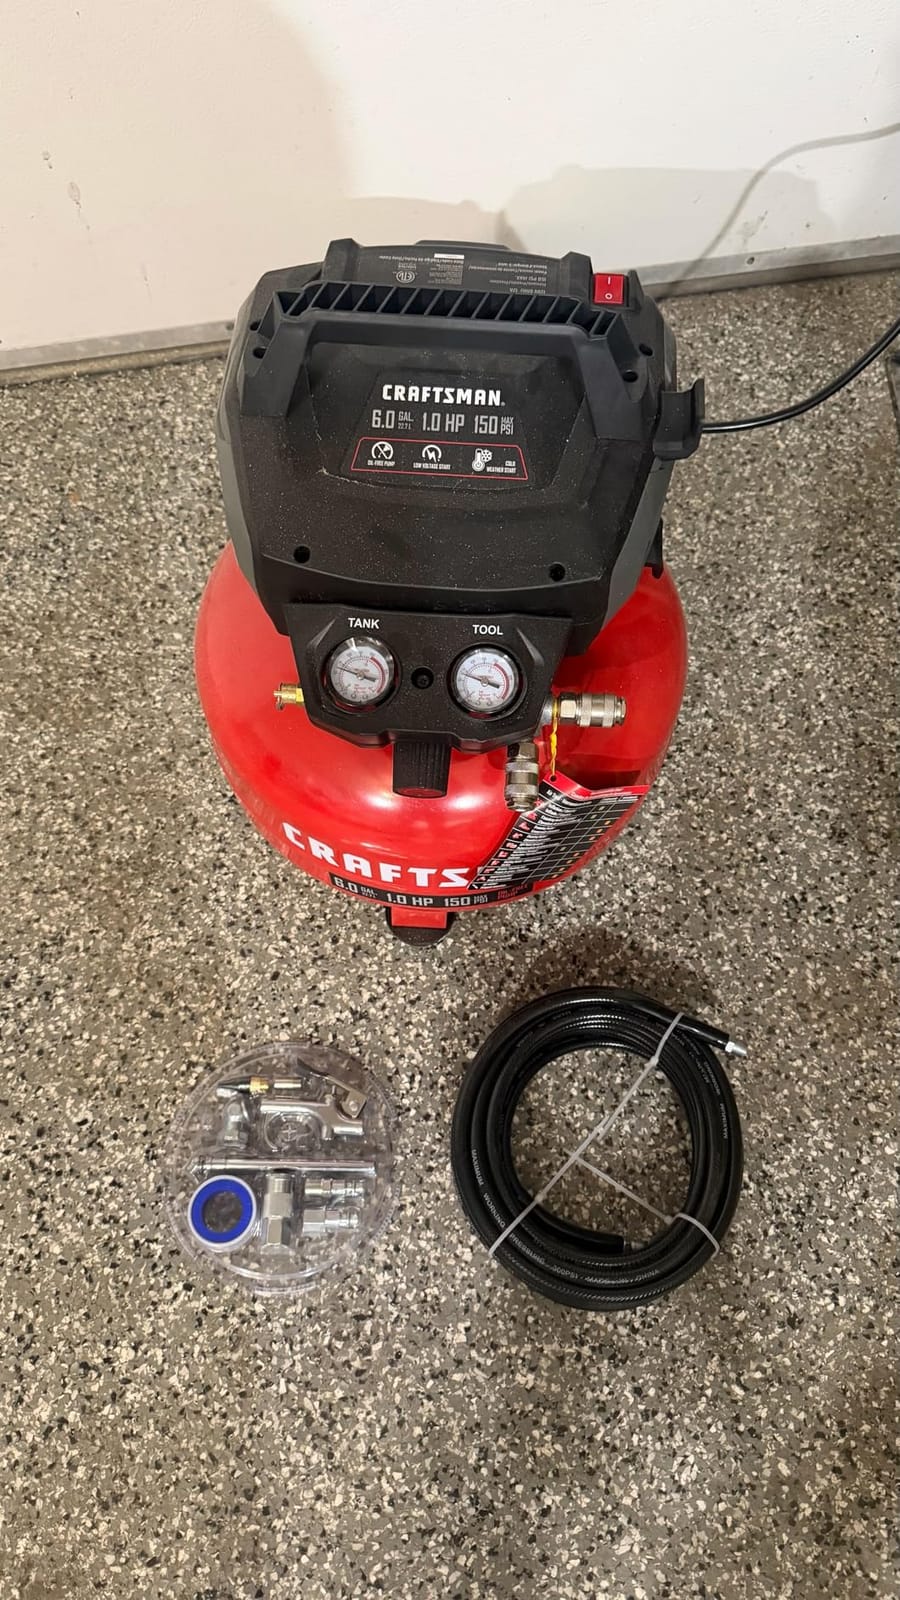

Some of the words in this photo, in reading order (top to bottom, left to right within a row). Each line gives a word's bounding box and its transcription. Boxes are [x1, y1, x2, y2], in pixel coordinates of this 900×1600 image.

[382, 384, 502, 406] CRAFTSMAN
[371, 409, 395, 429] 6.0
[422, 412, 441, 431] 1.0
[445, 413, 465, 433] HP
[474, 414, 498, 435] 150
[501, 416, 514, 425] MAX
[500, 424, 514, 435] PSI
[348, 617, 380, 630] TANK
[472, 624, 504, 636] TOOL
[282, 822, 470, 889] CRAFTS
[333, 877, 358, 895] 6.0
[386, 892, 408, 905] 1.0
[412, 896, 434, 907] HP
[444, 896, 471, 907] 150
[470, 1149, 485, 1187] MAXIMUM
